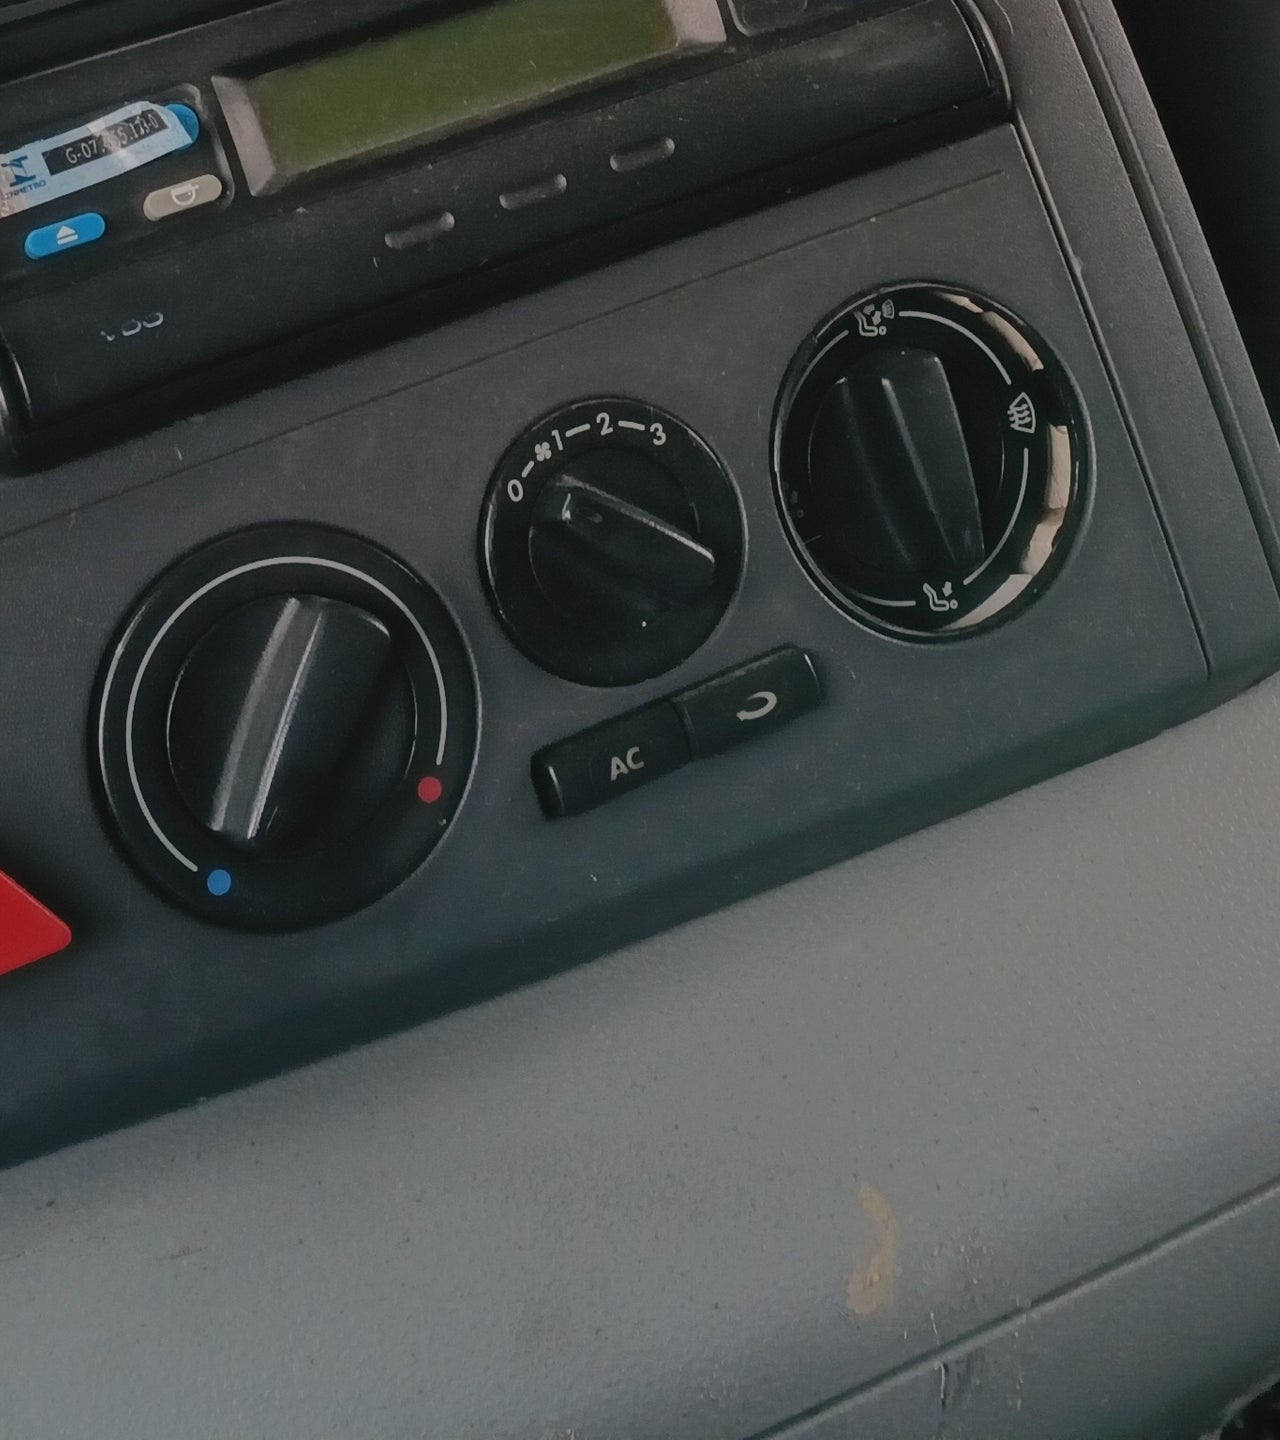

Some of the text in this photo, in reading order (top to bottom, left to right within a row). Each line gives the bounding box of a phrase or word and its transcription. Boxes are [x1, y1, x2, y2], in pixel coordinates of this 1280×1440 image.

[506, 412, 667, 503] 0 1 2 3
[610, 746, 645, 781] AC
